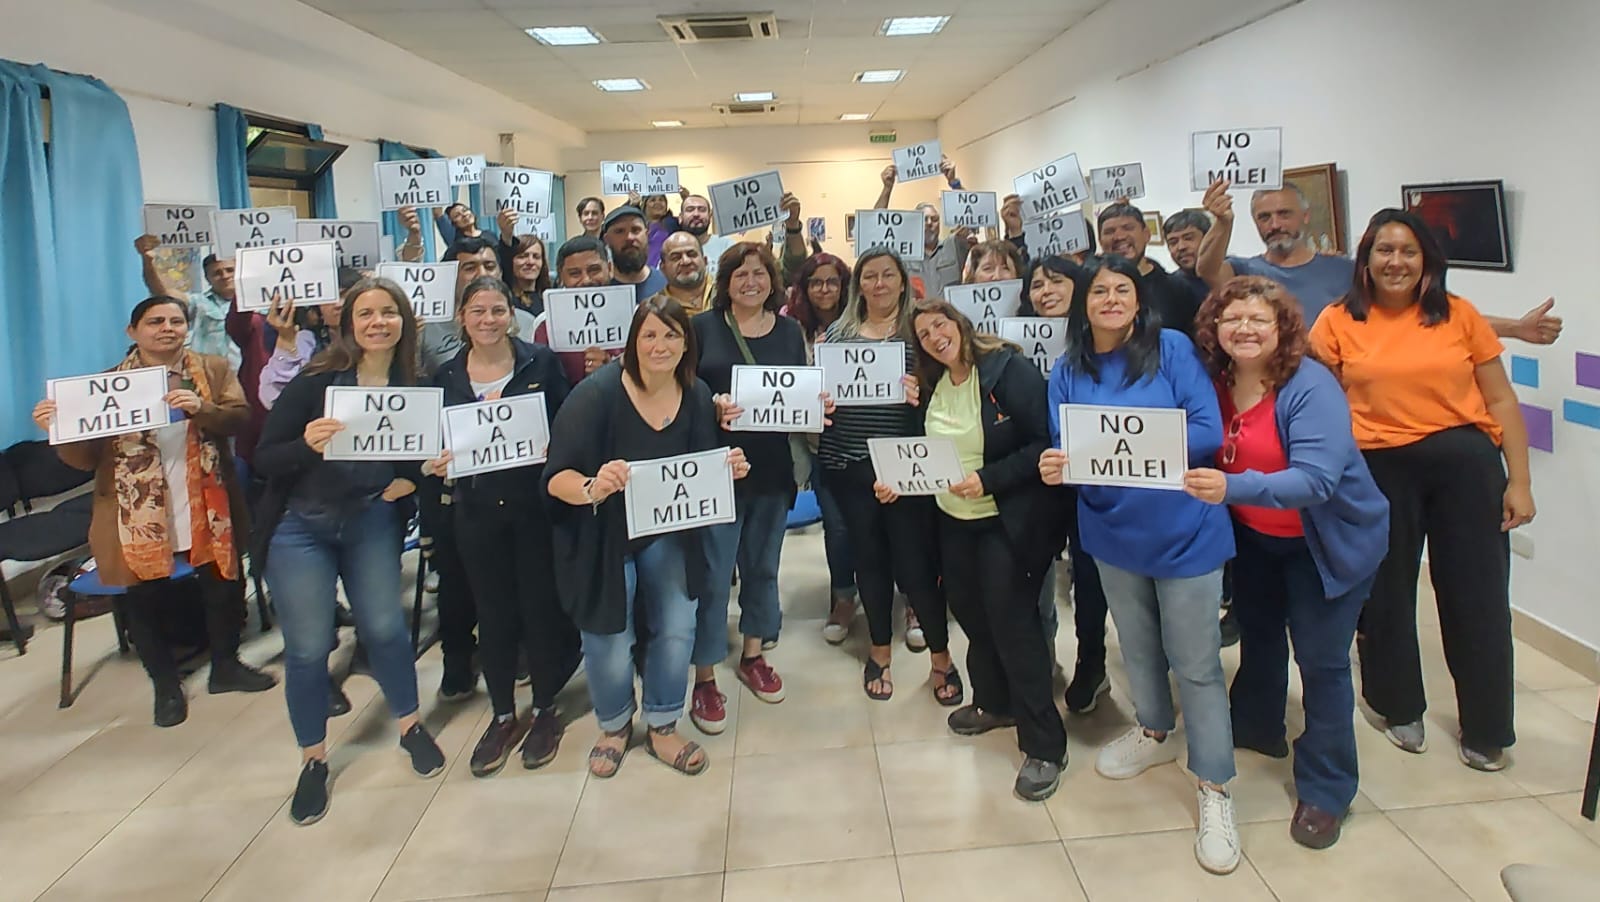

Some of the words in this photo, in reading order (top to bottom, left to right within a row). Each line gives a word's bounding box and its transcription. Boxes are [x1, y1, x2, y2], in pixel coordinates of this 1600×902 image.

[1217, 132, 1250, 149] NO
[908, 146, 926, 157] NO
[457, 157, 473, 166] NO
[915, 157, 923, 166] A
[1225, 152, 1240, 166] A
[400, 164, 425, 176] NO
[617, 164, 634, 172] NO
[651, 168, 665, 176] NO
[907, 164, 938, 177] MILEI
[1032, 164, 1057, 183] NO
[1106, 167, 1126, 178] NO
[504, 172, 530, 184] NO
[623, 174, 630, 182] A
[656, 176, 662, 184] A
[1114, 178, 1122, 188] A
[1208, 168, 1266, 185] MILEI
[408, 178, 419, 190] A
[613, 183, 642, 192] MILEI
[648, 183, 673, 192] MILEI
[734, 180, 760, 198] NO
[1043, 180, 1055, 194] A
[395, 190, 440, 204] MILEI
[510, 186, 522, 198] A
[958, 193, 978, 205] NO
[746, 198, 758, 210] A
[1033, 186, 1078, 213] MILEI
[168, 208, 194, 219] NO
[964, 205, 973, 215] A
[240, 212, 270, 225] NO
[733, 207, 778, 229] MILEI
[878, 212, 902, 226] NO
[954, 214, 988, 225] MILEI
[1038, 218, 1063, 231] NO
[177, 222, 188, 231] A
[251, 228, 263, 238] A
[322, 225, 352, 238] NO
[161, 232, 210, 244] MILEI
[885, 229, 895, 239] A
[1050, 232, 1059, 243] A
[269, 248, 303, 265] NO
[340, 256, 367, 268] LEI
[280, 268, 295, 281] A
[404, 268, 434, 282] NO
[261, 282, 322, 302] MILEI
[412, 286, 425, 299] A
[973, 287, 1001, 302] NO
[412, 301, 446, 316] ILEI
[575, 294, 605, 309] NO
[983, 304, 995, 318] A
[585, 312, 598, 326] A
[976, 320, 998, 334] MIL
[1024, 324, 1052, 338] NO
[569, 327, 622, 344] MILEI
[1034, 342, 1046, 355] A
[845, 349, 875, 363] NO
[763, 372, 795, 387] NO
[854, 367, 867, 381] A
[89, 376, 130, 395] NO
[837, 383, 891, 398] MILEI
[102, 396, 120, 411] A
[365, 394, 406, 412] NO
[771, 391, 784, 406] A
[78, 409, 150, 433] MILEI
[477, 404, 513, 425] NO
[753, 408, 808, 425] MILEI
[377, 414, 394, 430] A
[1101, 414, 1143, 435] NO
[491, 426, 506, 442] A
[353, 434, 423, 452] MILEI
[1114, 439, 1132, 455] A
[472, 442, 534, 466] MILEI
[897, 443, 928, 459] NO
[662, 461, 698, 482] NO
[912, 463, 925, 476] A
[1092, 458, 1166, 478] MILEI
[674, 483, 689, 500] A
[654, 499, 717, 524] MILEI
